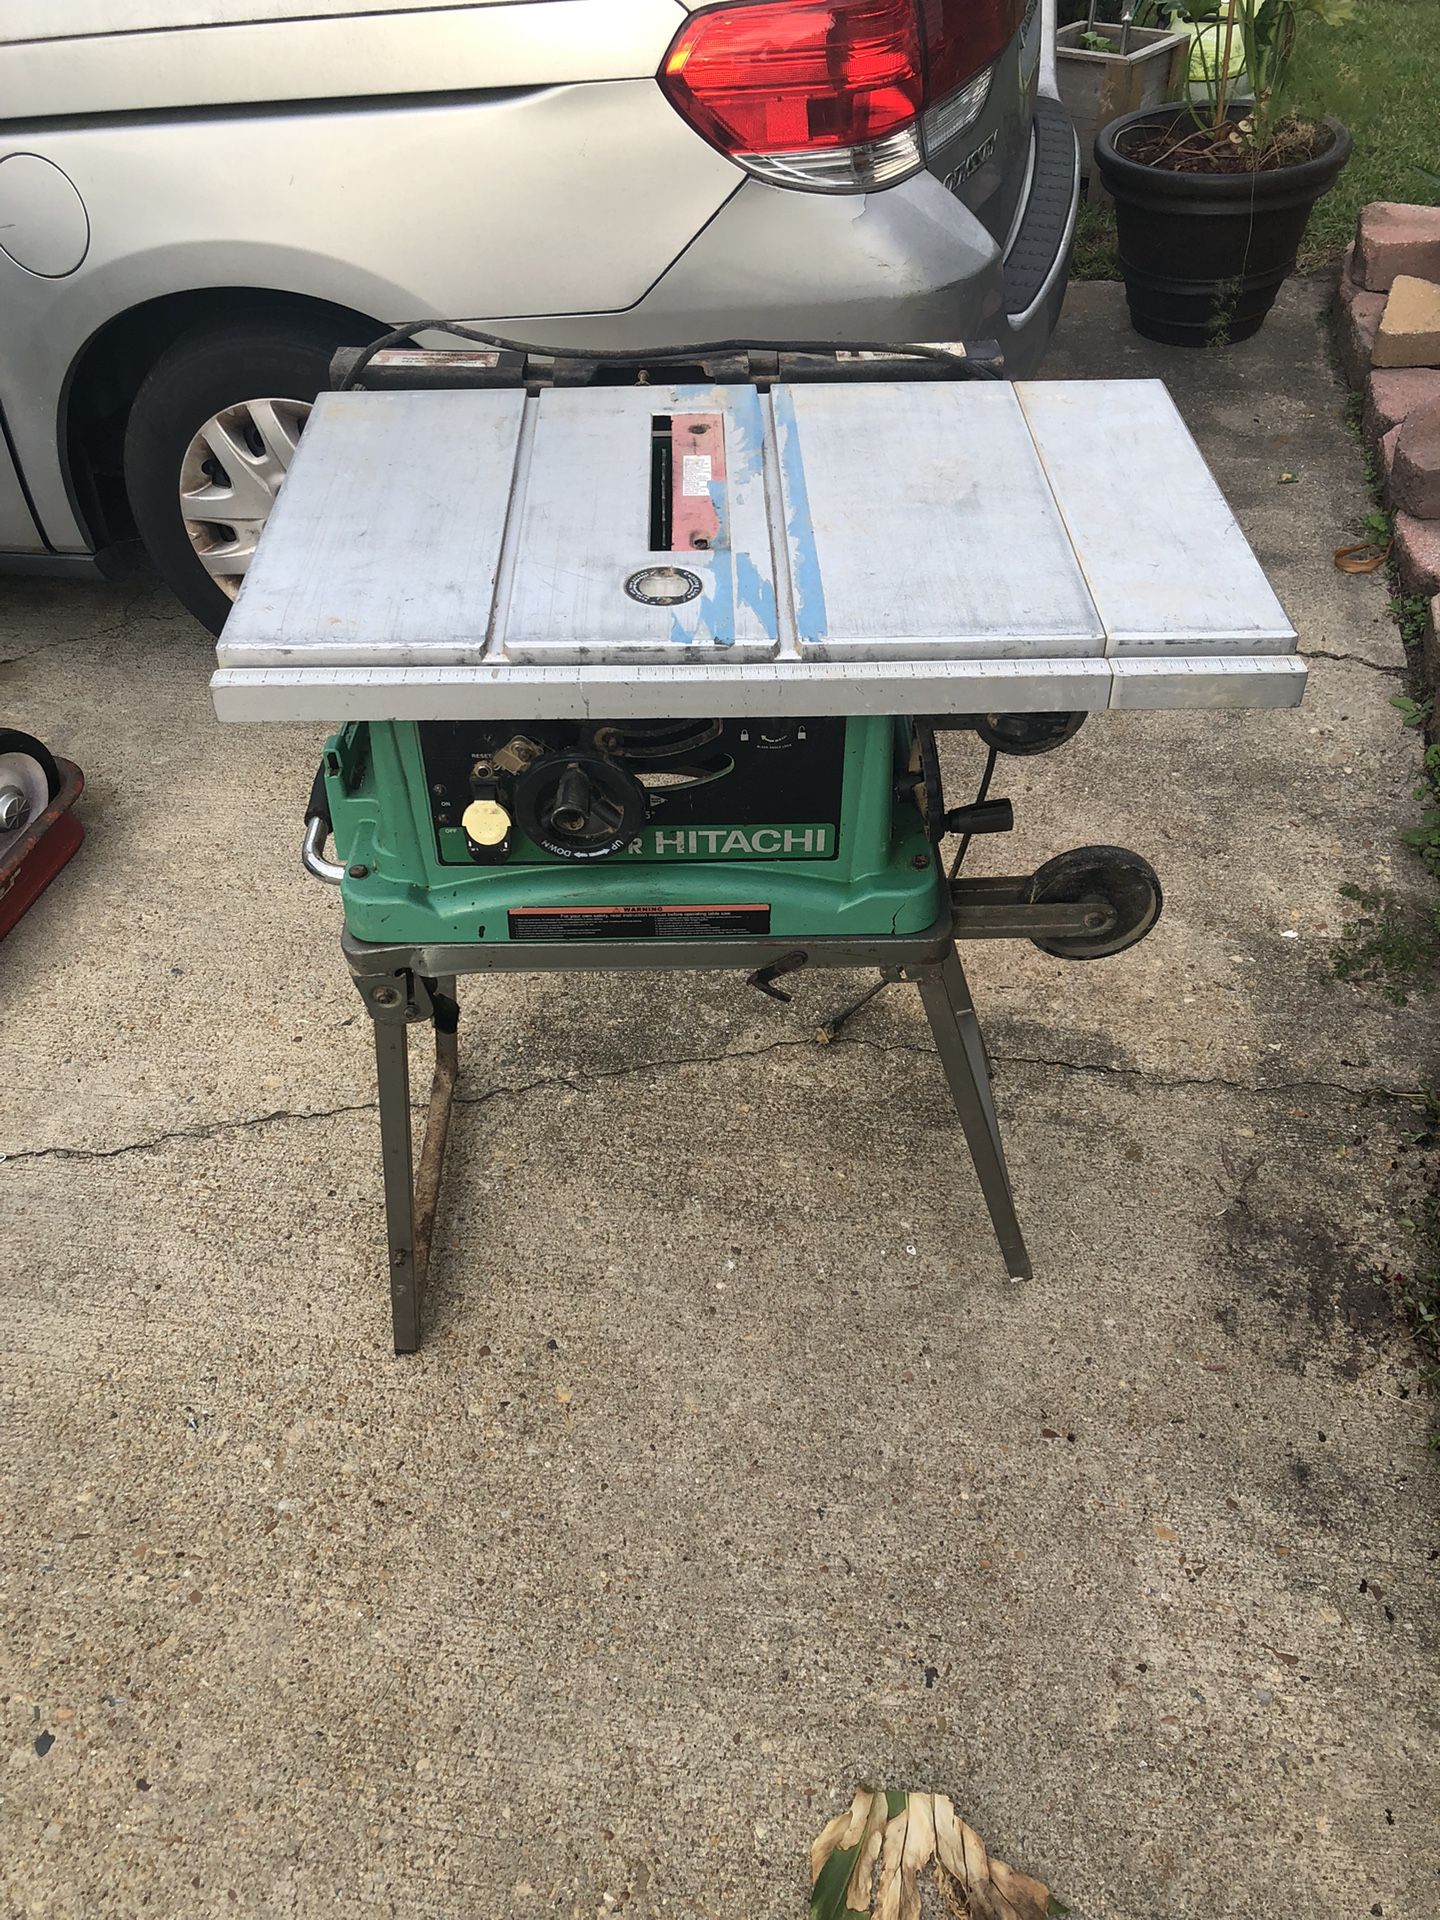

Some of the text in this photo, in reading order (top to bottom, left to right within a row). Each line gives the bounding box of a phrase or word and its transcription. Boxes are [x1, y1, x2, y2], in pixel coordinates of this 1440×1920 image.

[541, 840, 572, 858] DOWN
[610, 839, 625, 851] UP
[655, 829, 826, 854] HITACHI
